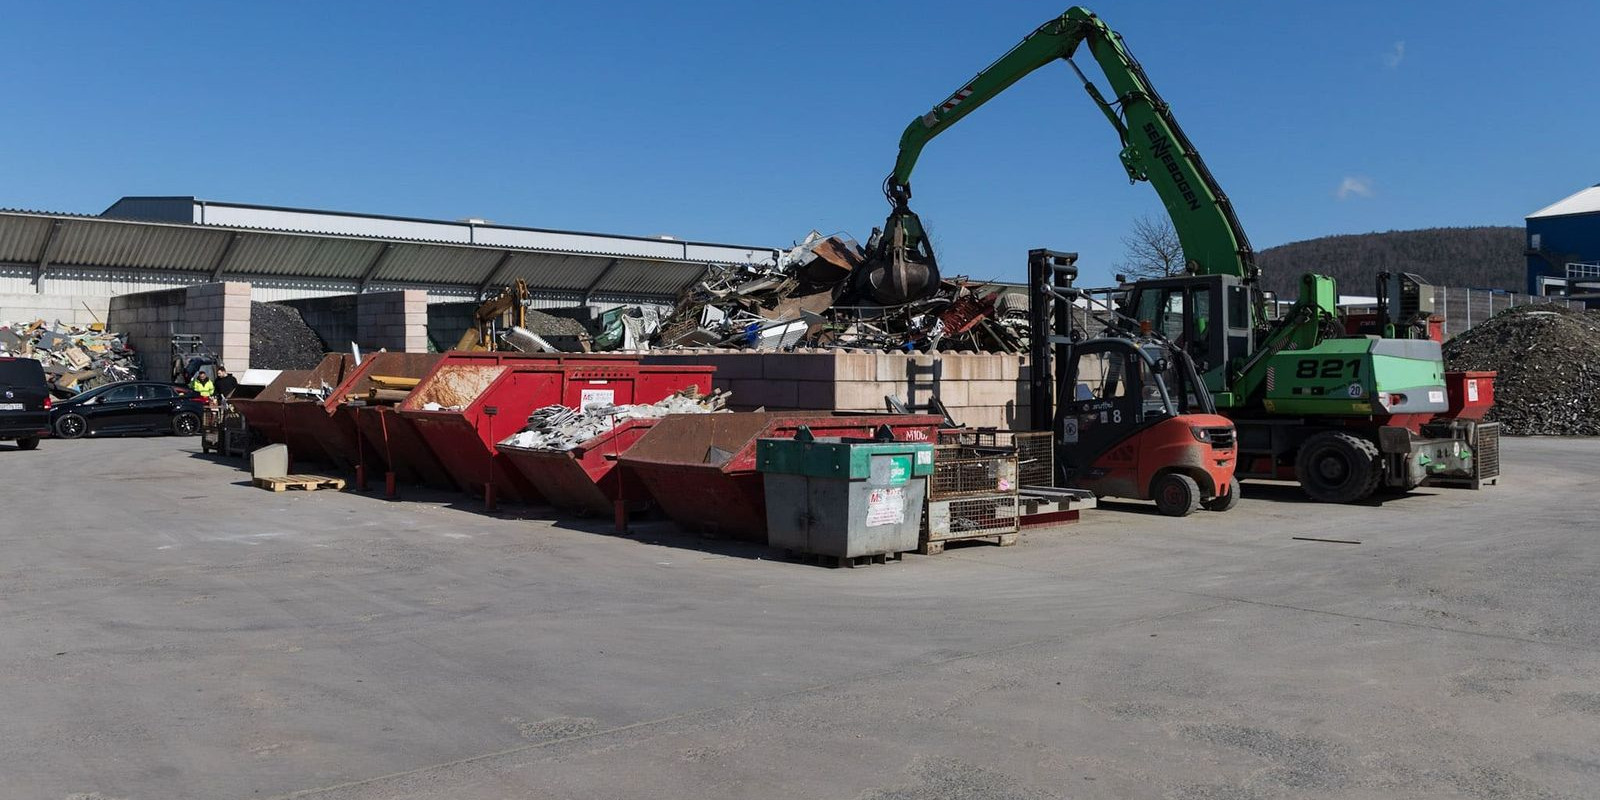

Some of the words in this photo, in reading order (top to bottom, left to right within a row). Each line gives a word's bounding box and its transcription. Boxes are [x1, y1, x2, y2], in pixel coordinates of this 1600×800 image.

[1143, 122, 1201, 211] SENNEBOGEN
[1296, 359, 1361, 378] 821
[1351, 386, 1360, 395] 20
[1113, 409, 1121, 423] 8
